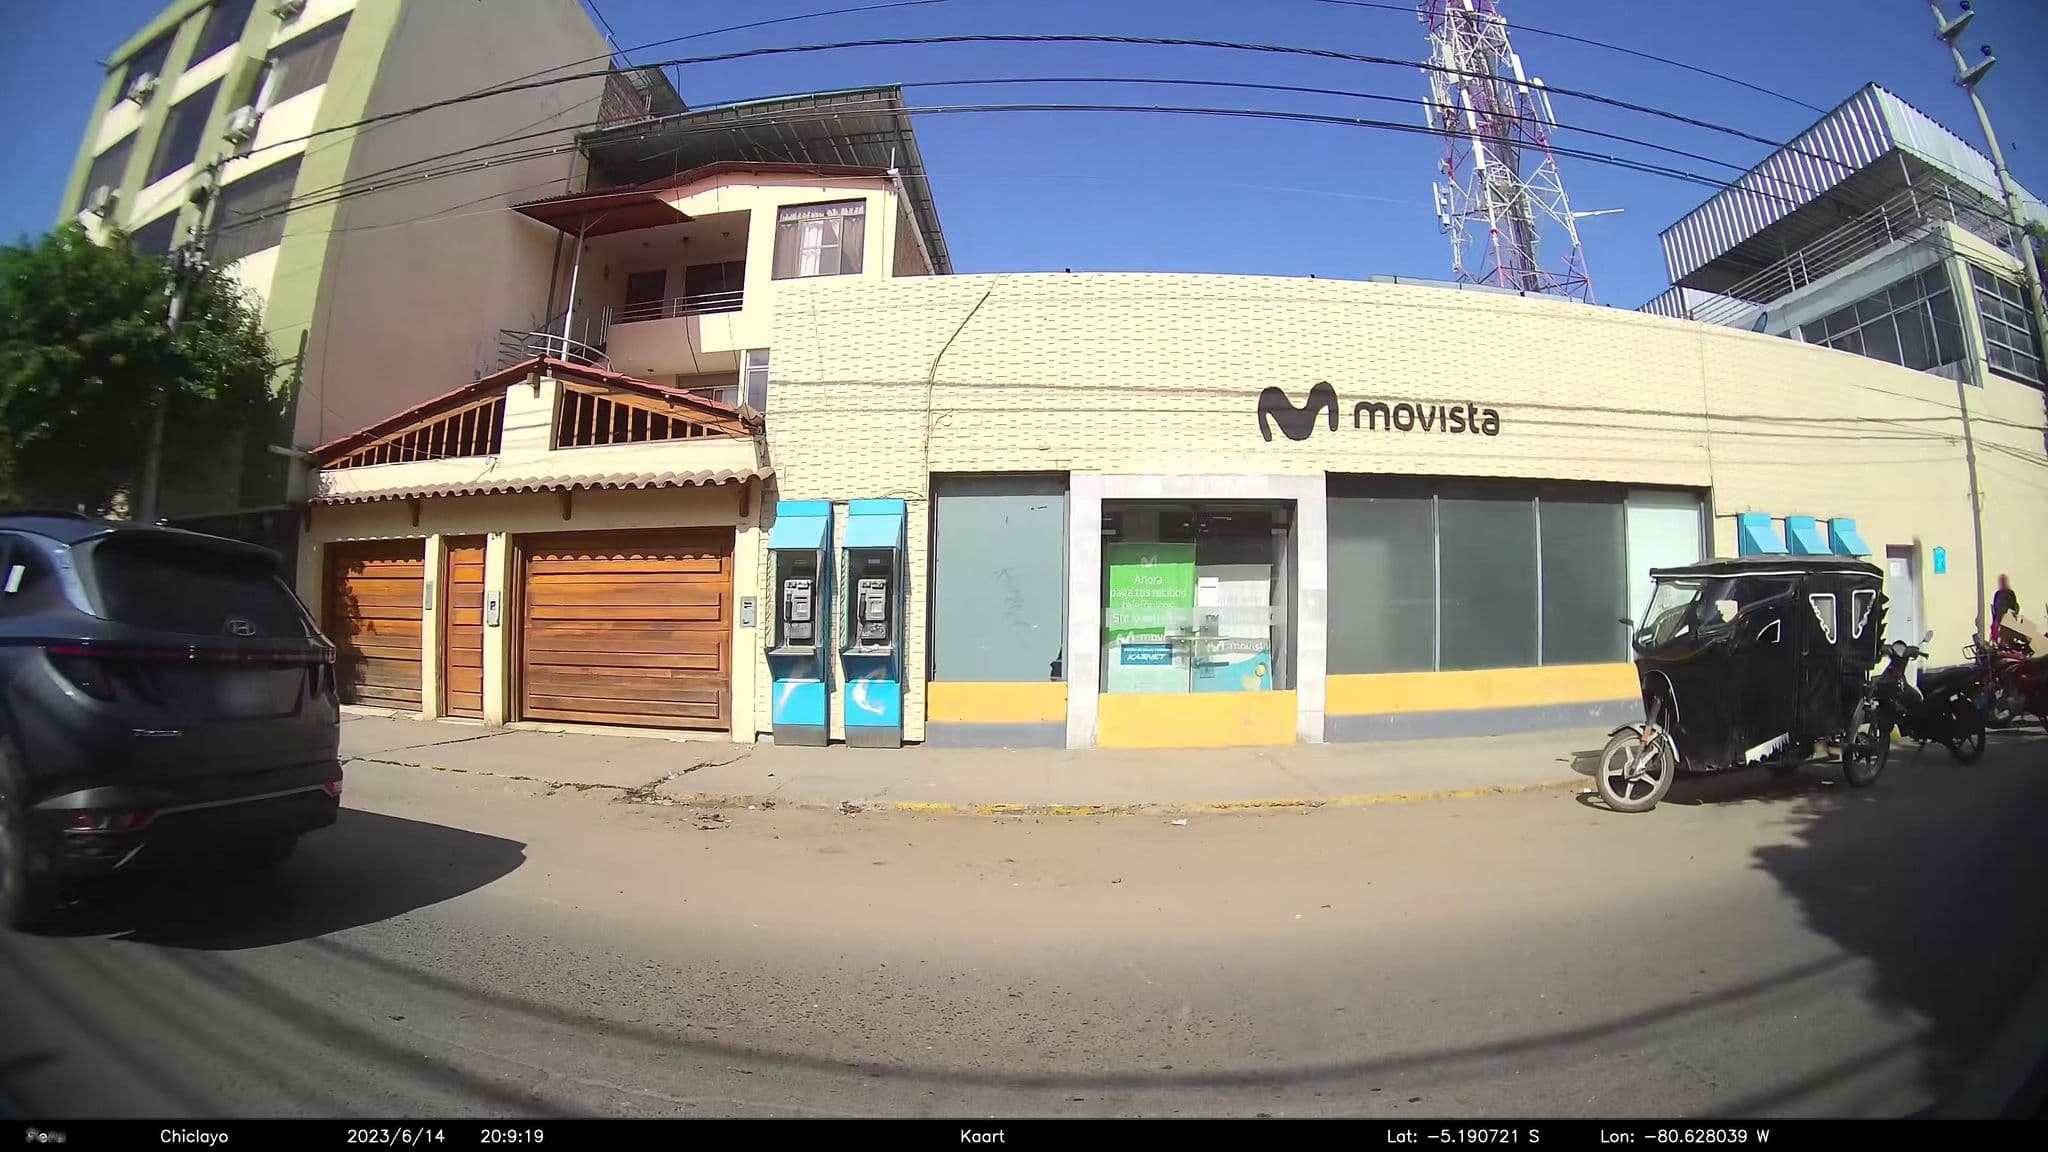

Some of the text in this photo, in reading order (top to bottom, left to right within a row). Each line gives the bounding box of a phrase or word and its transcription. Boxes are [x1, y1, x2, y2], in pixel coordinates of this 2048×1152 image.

[1134, 574, 1163, 585] Ahora
[1111, 586, 1187, 599] paga tus recibos
